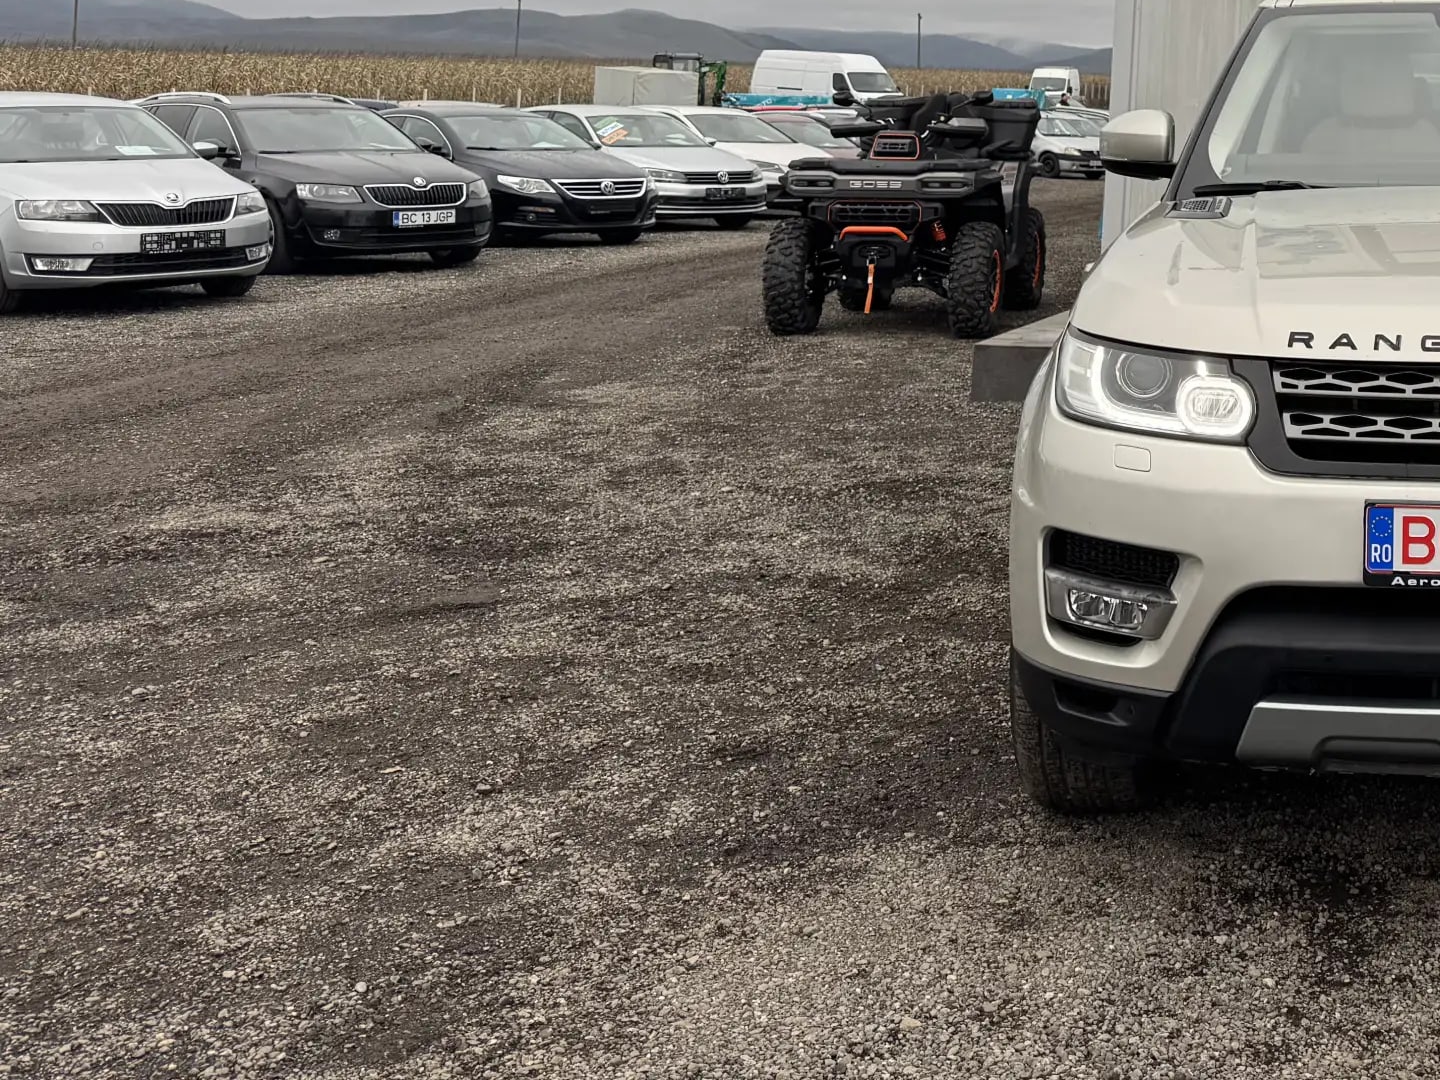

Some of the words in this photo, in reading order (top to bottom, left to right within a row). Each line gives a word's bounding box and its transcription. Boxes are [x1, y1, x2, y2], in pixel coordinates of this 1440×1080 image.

[849, 180, 903, 189] GOES
[401, 212, 417, 224] BC
[421, 212, 431, 223] 13
[433, 210, 453, 223] JGP
[1370, 543, 1392, 564] RO
